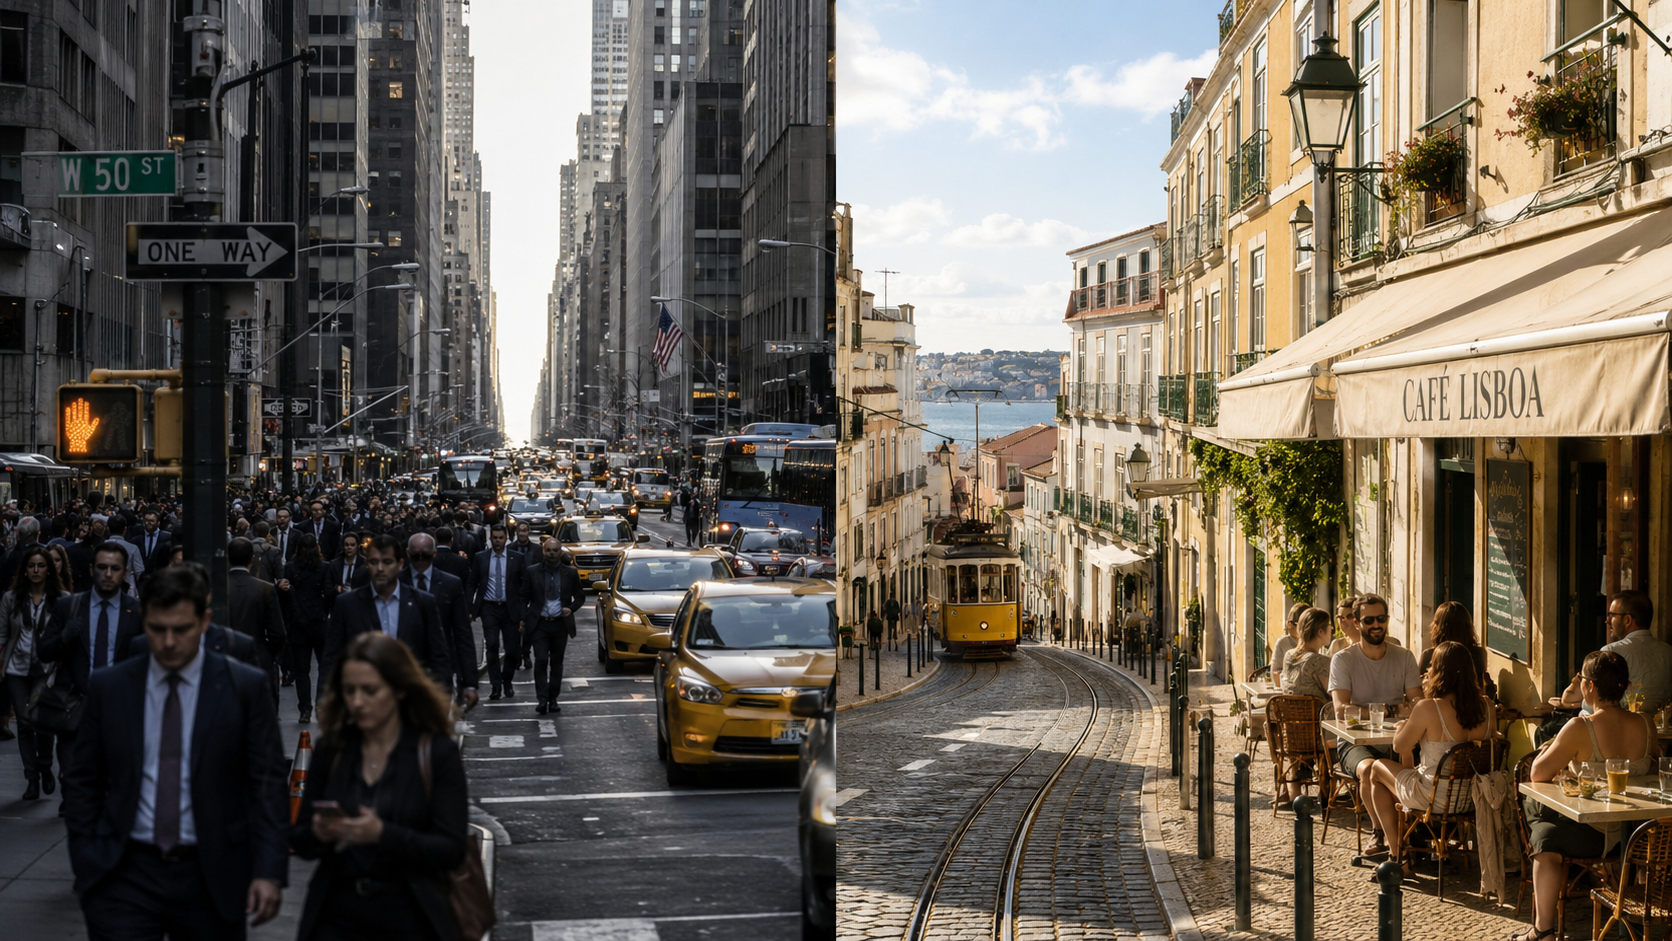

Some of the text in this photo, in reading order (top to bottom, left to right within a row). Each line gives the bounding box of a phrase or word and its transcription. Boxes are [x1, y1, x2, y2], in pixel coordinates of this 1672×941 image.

[62, 156, 164, 191] W 50 ST
[148, 242, 272, 262] ONE WAY
[1402, 364, 1545, 423] CAFÉ LISBOA
